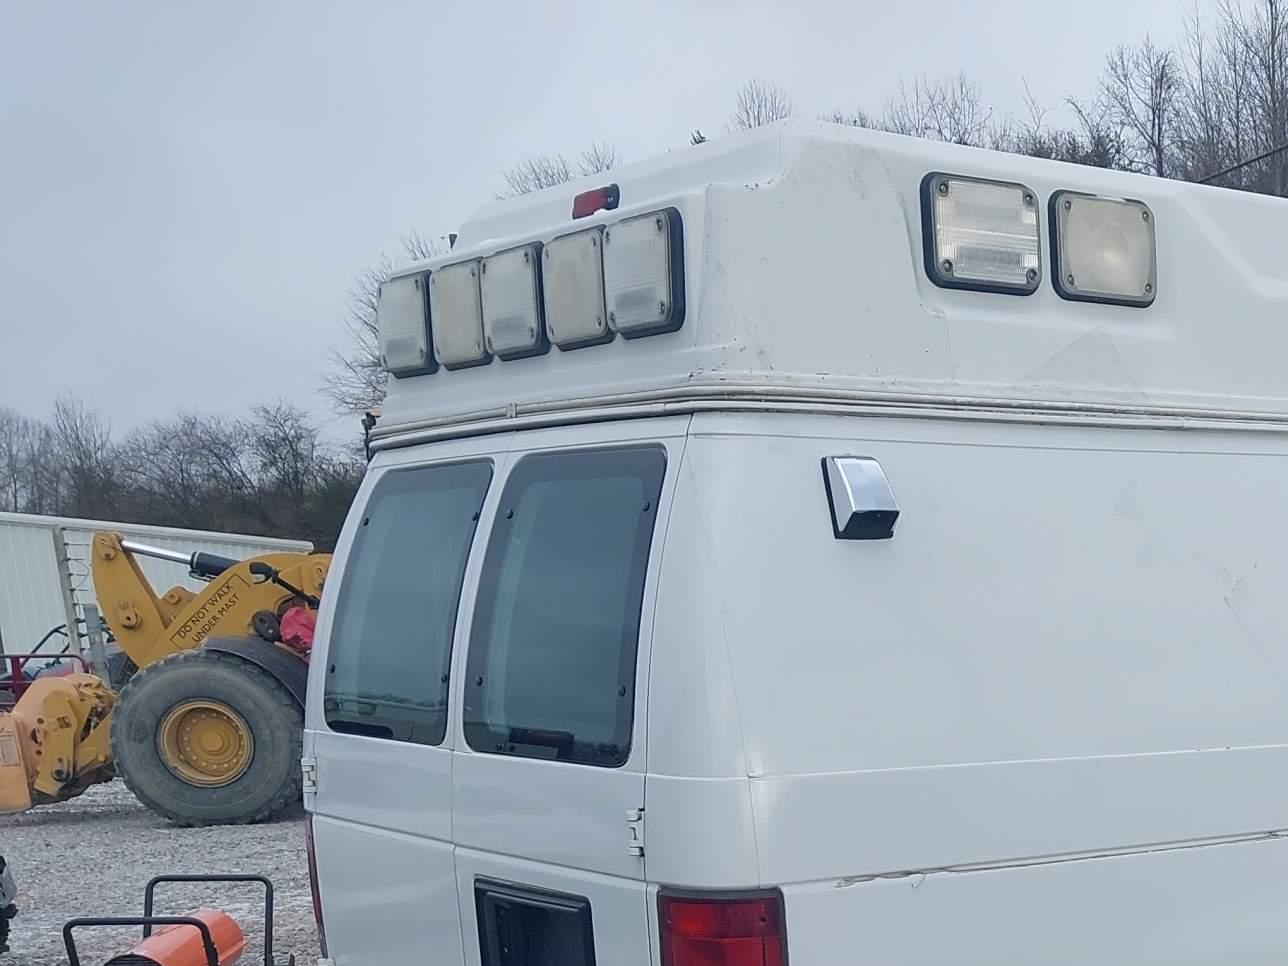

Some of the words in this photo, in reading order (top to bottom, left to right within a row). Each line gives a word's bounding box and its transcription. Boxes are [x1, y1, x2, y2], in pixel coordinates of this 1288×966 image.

[177, 624, 193, 639] DO
[191, 604, 210, 625] NOT
[207, 582, 234, 606] WALK
[191, 615, 220, 643] UNDER
[218, 593, 241, 616] MAST
